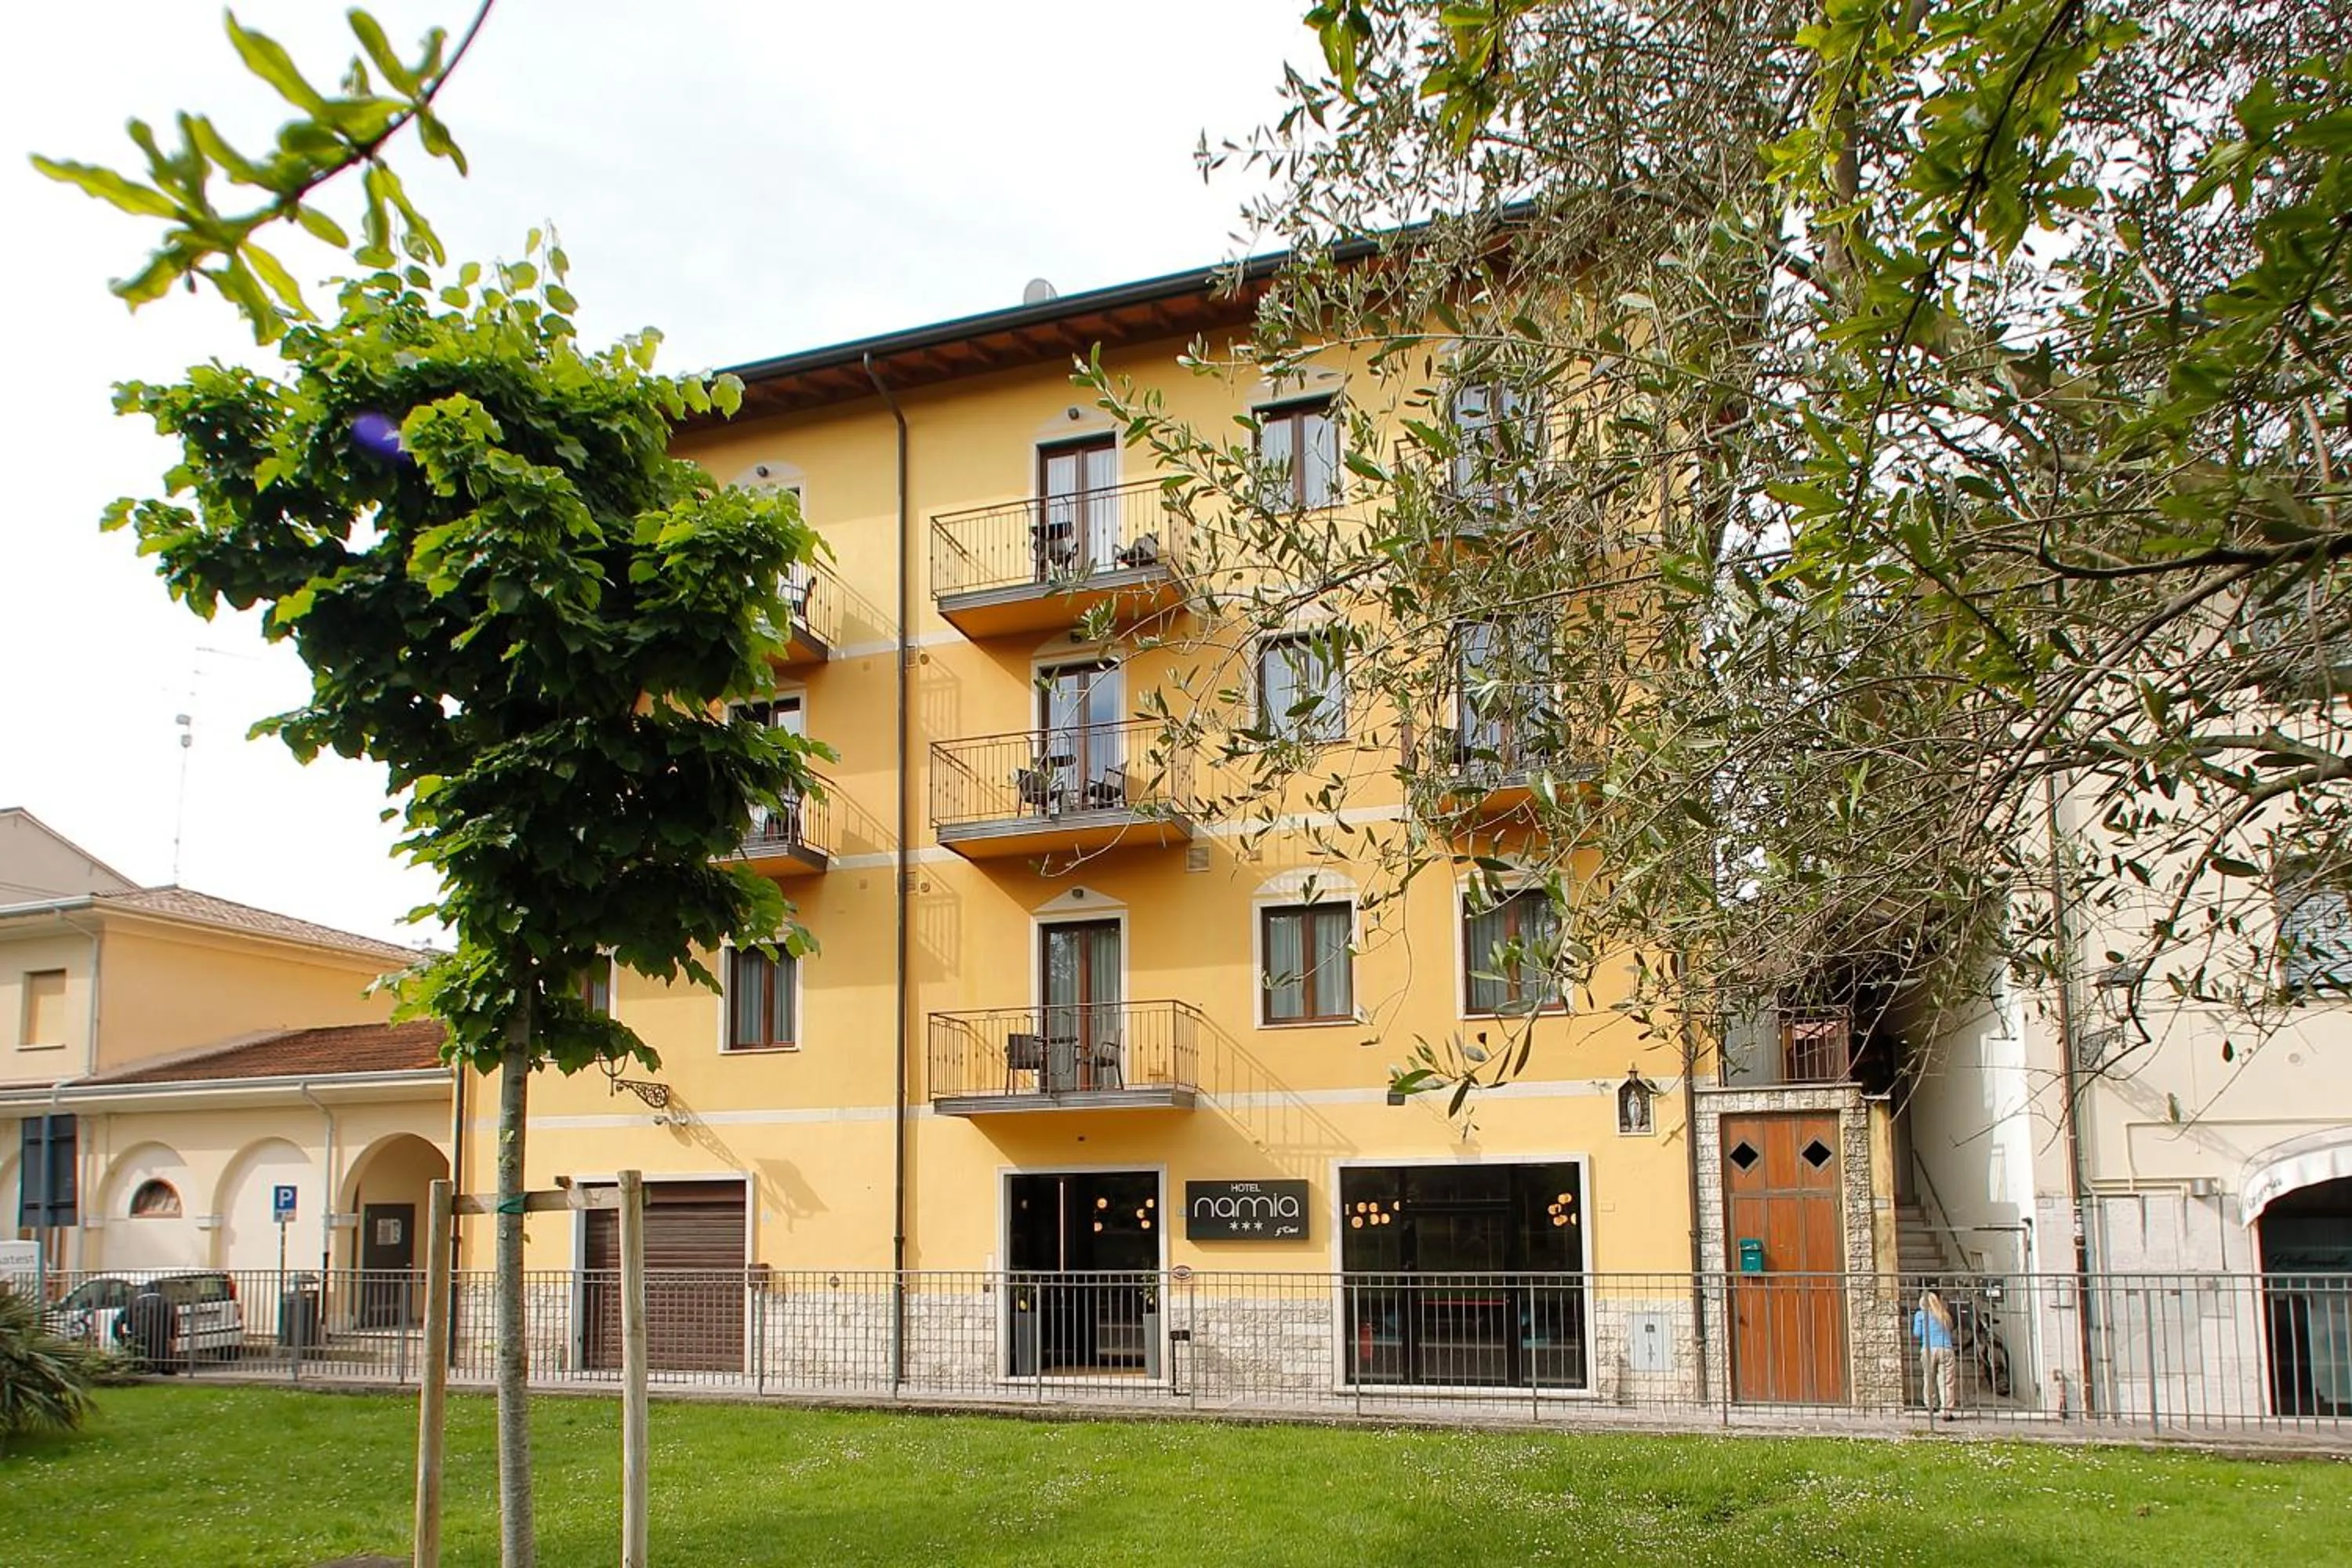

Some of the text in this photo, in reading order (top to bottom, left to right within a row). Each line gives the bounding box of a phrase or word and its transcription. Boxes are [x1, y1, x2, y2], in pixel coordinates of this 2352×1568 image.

[1230, 1183, 1261, 1192] HOTEL
[278, 1189, 293, 1208] P
[1194, 1192, 1299, 1218] namia
